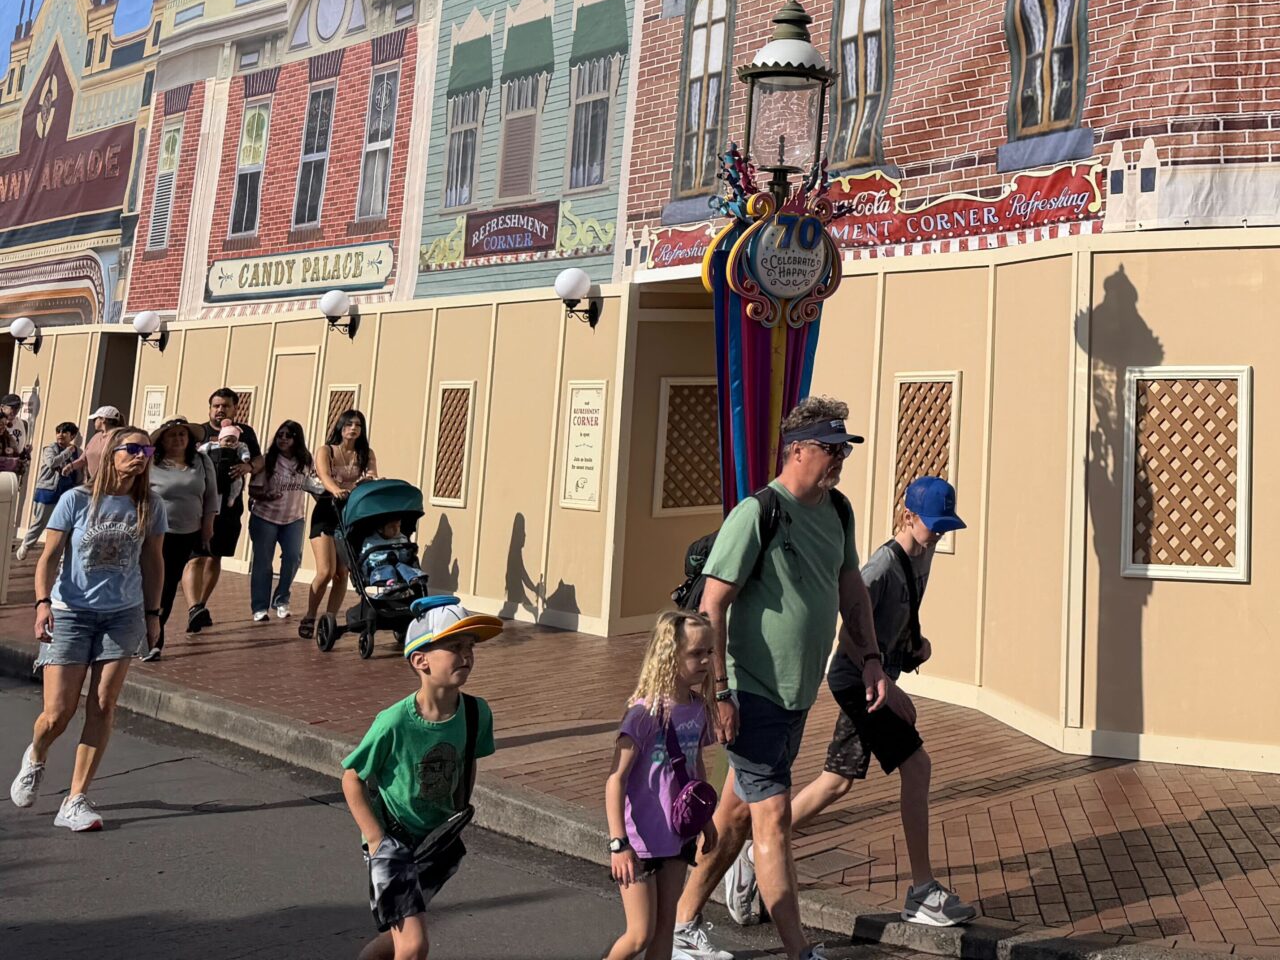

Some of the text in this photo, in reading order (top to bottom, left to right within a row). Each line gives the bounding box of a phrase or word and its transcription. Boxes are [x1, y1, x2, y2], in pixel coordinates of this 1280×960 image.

[40, 143, 121, 190] ARCADE
[906, 206, 999, 234] CORNER
[1006, 186, 1090, 221] Refreshing
[471, 214, 549, 248] REFRESHMENT
[483, 232, 534, 251] CORNER
[775, 212, 823, 250] 70
[238, 251, 364, 289] CANDY PALACE
[778, 265, 808, 278] HAPPY
[572, 416, 599, 427] CORNER
